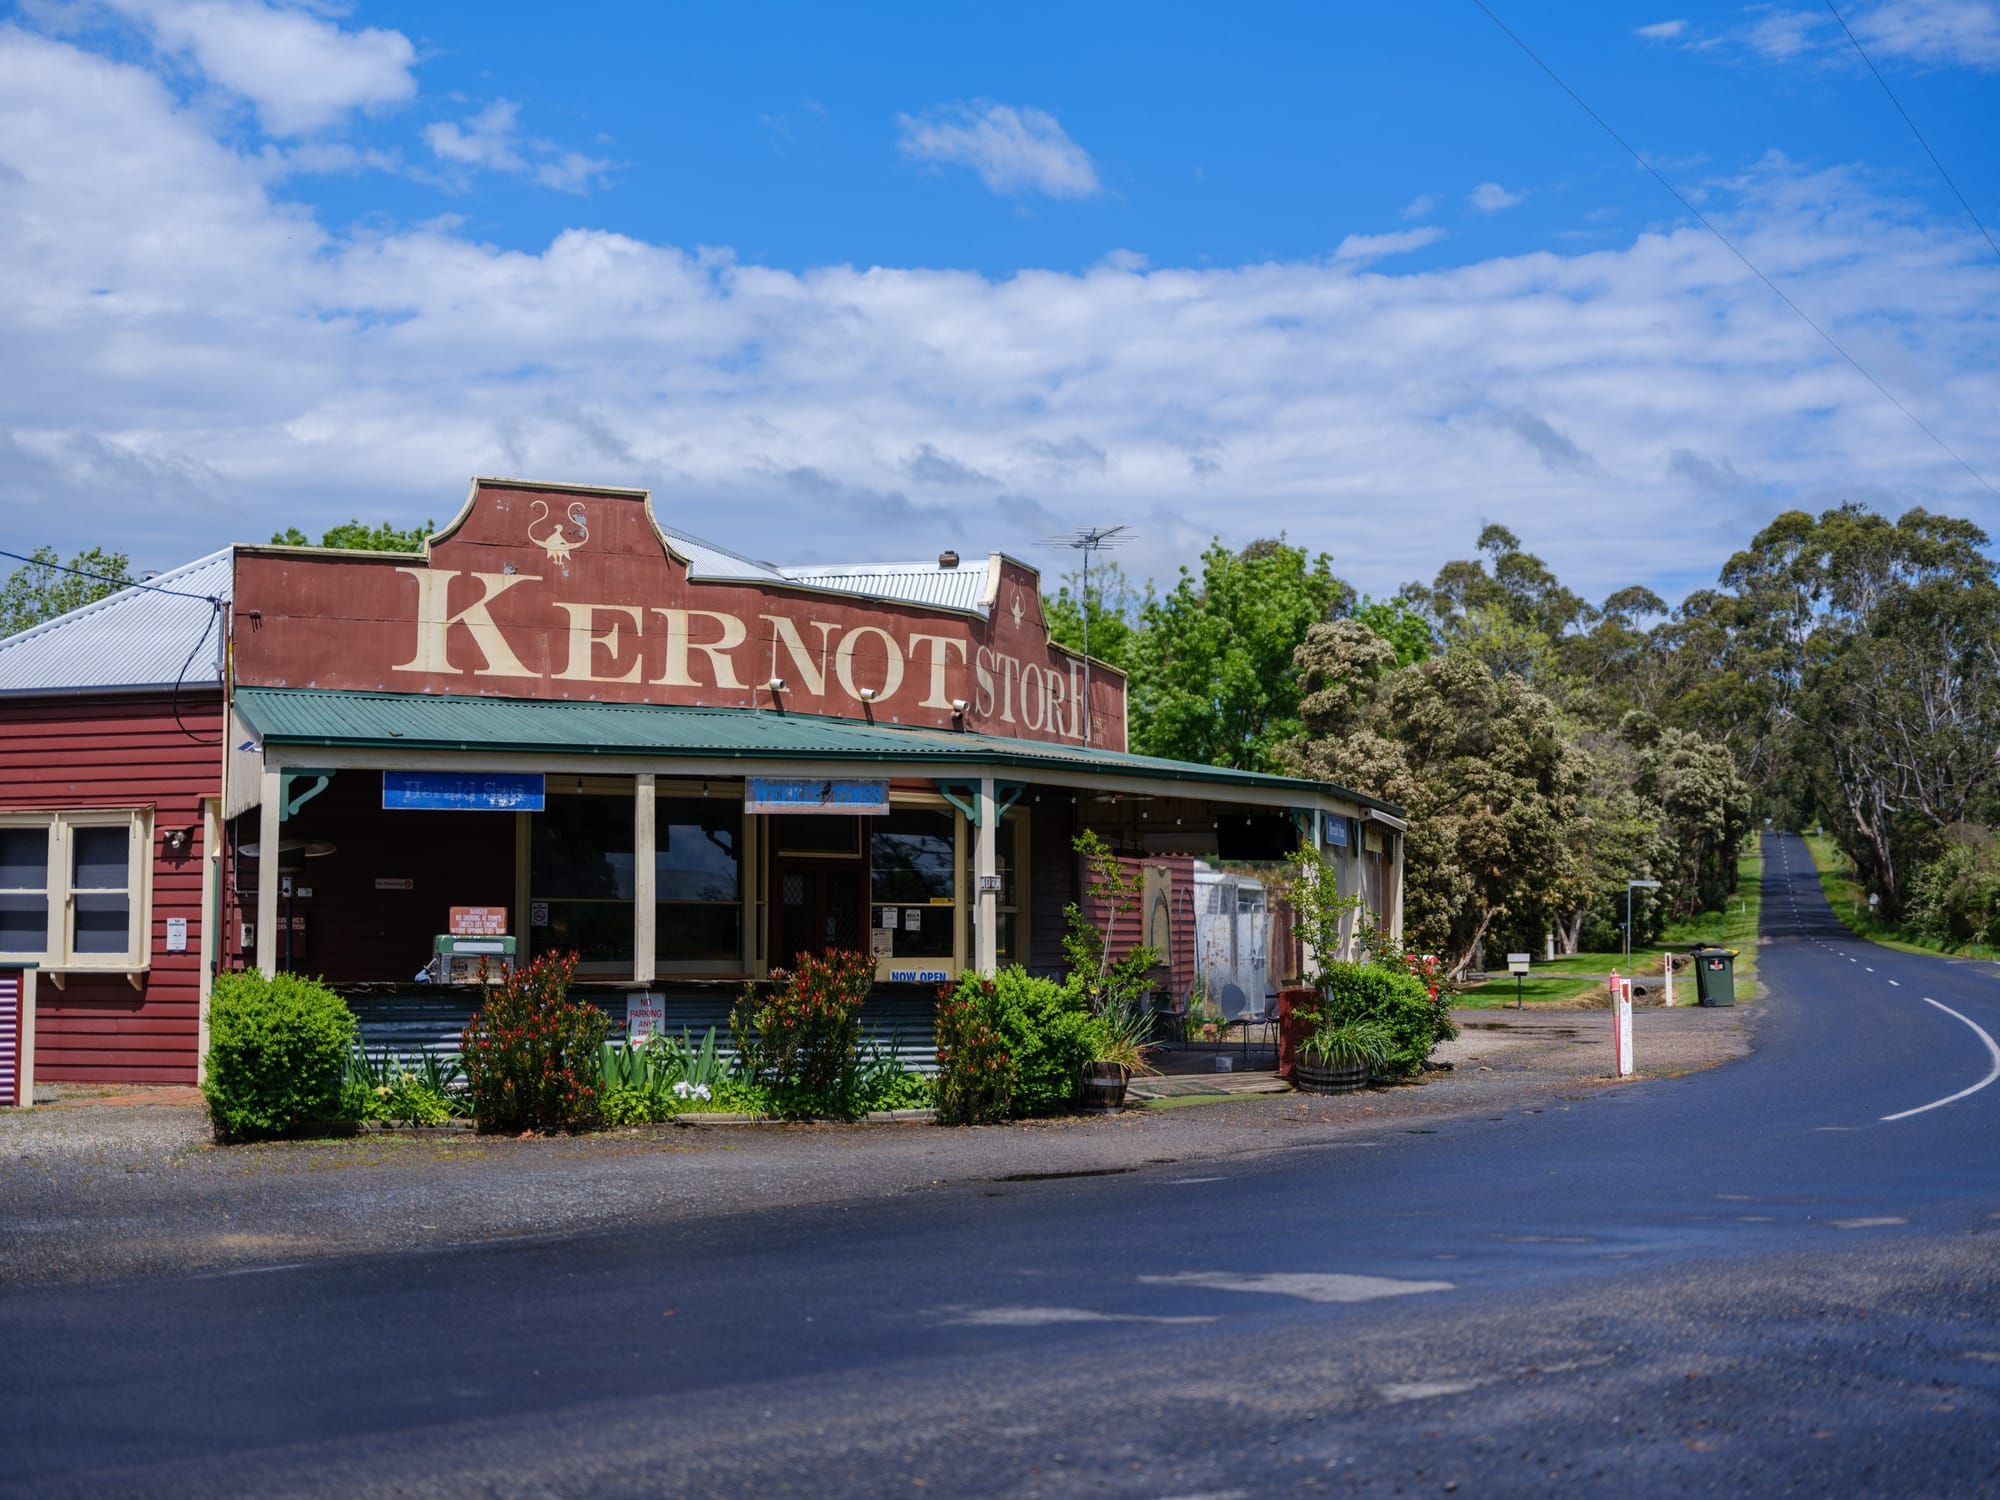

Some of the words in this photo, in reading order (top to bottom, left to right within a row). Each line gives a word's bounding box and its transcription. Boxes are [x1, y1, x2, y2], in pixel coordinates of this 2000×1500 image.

[392, 567, 967, 710] KERNOT
[975, 645, 1091, 742] STORE
[832, 785, 883, 805] TIMES
[892, 971, 916, 981] NOW
[920, 971, 947, 981] OPEN
[640, 998, 652, 1006] NO
[630, 1009, 662, 1018] PARKING
